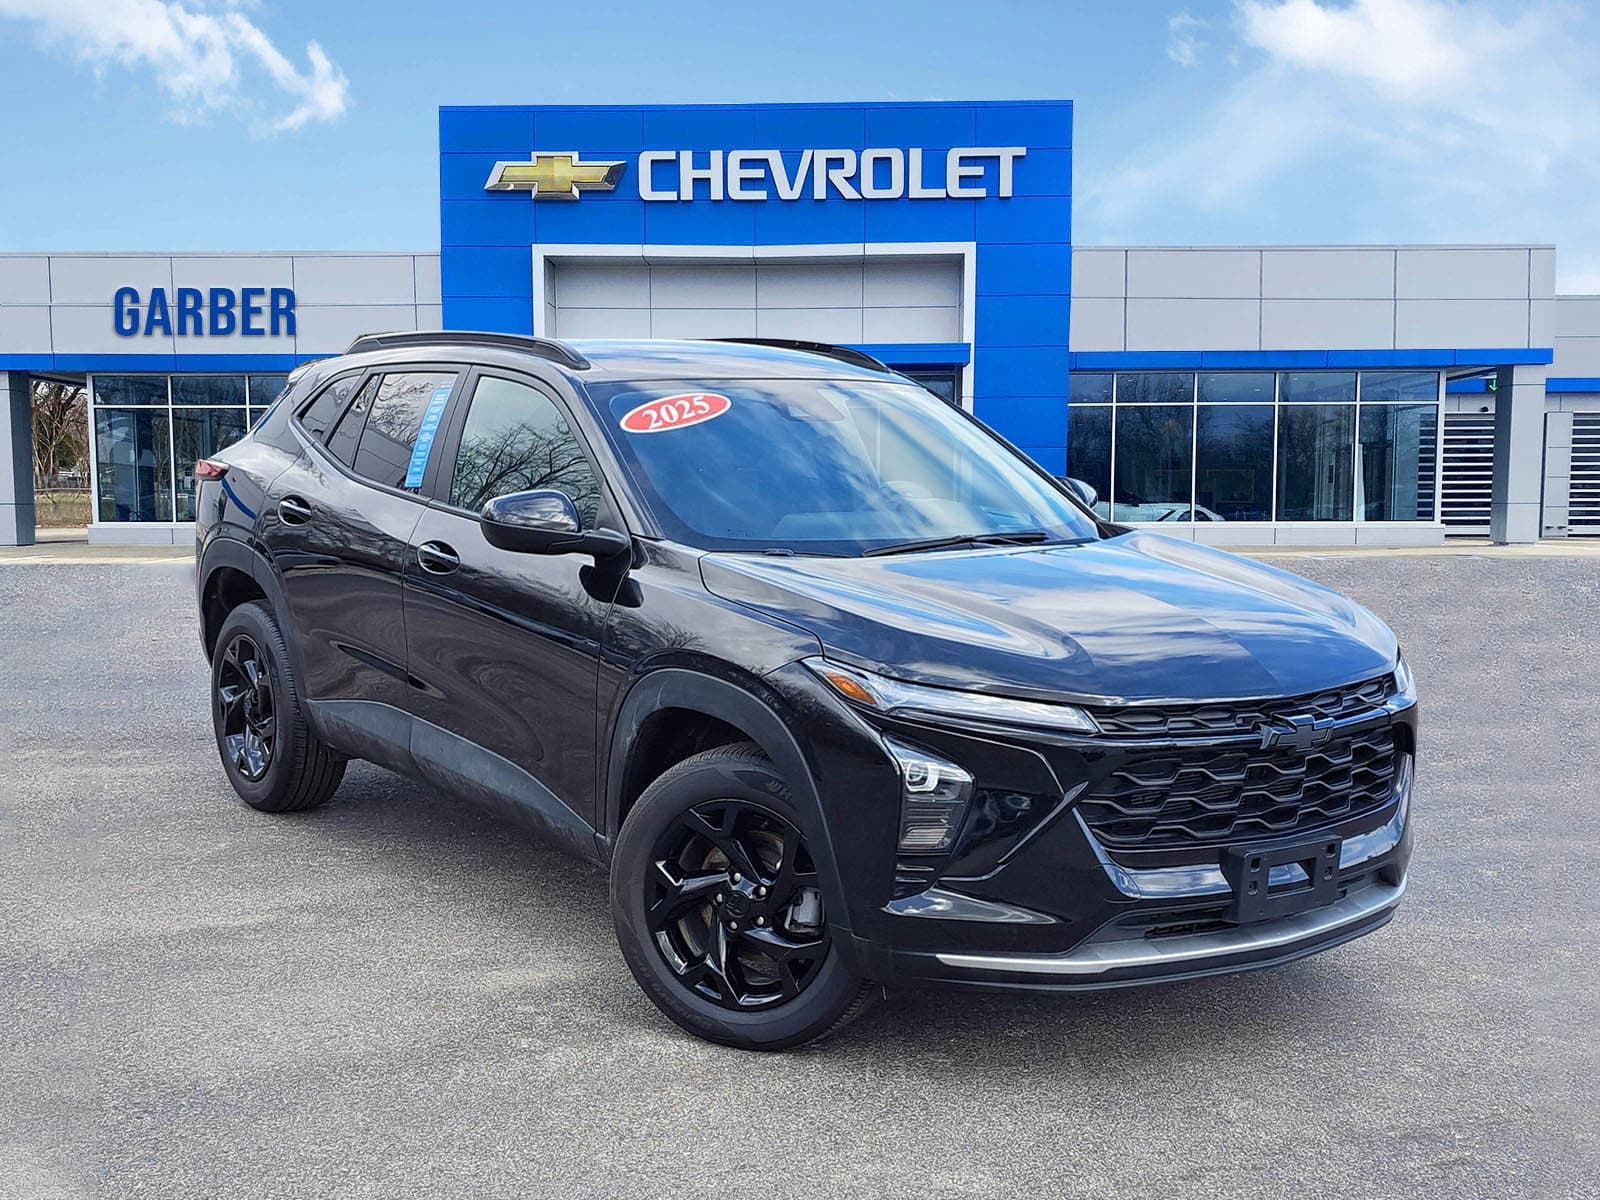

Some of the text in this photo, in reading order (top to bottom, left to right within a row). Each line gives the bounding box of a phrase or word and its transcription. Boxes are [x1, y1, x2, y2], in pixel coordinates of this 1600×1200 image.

[638, 146, 1027, 201] CHEVROLET
[114, 286, 297, 337] GARBER
[642, 395, 711, 429] 2025
